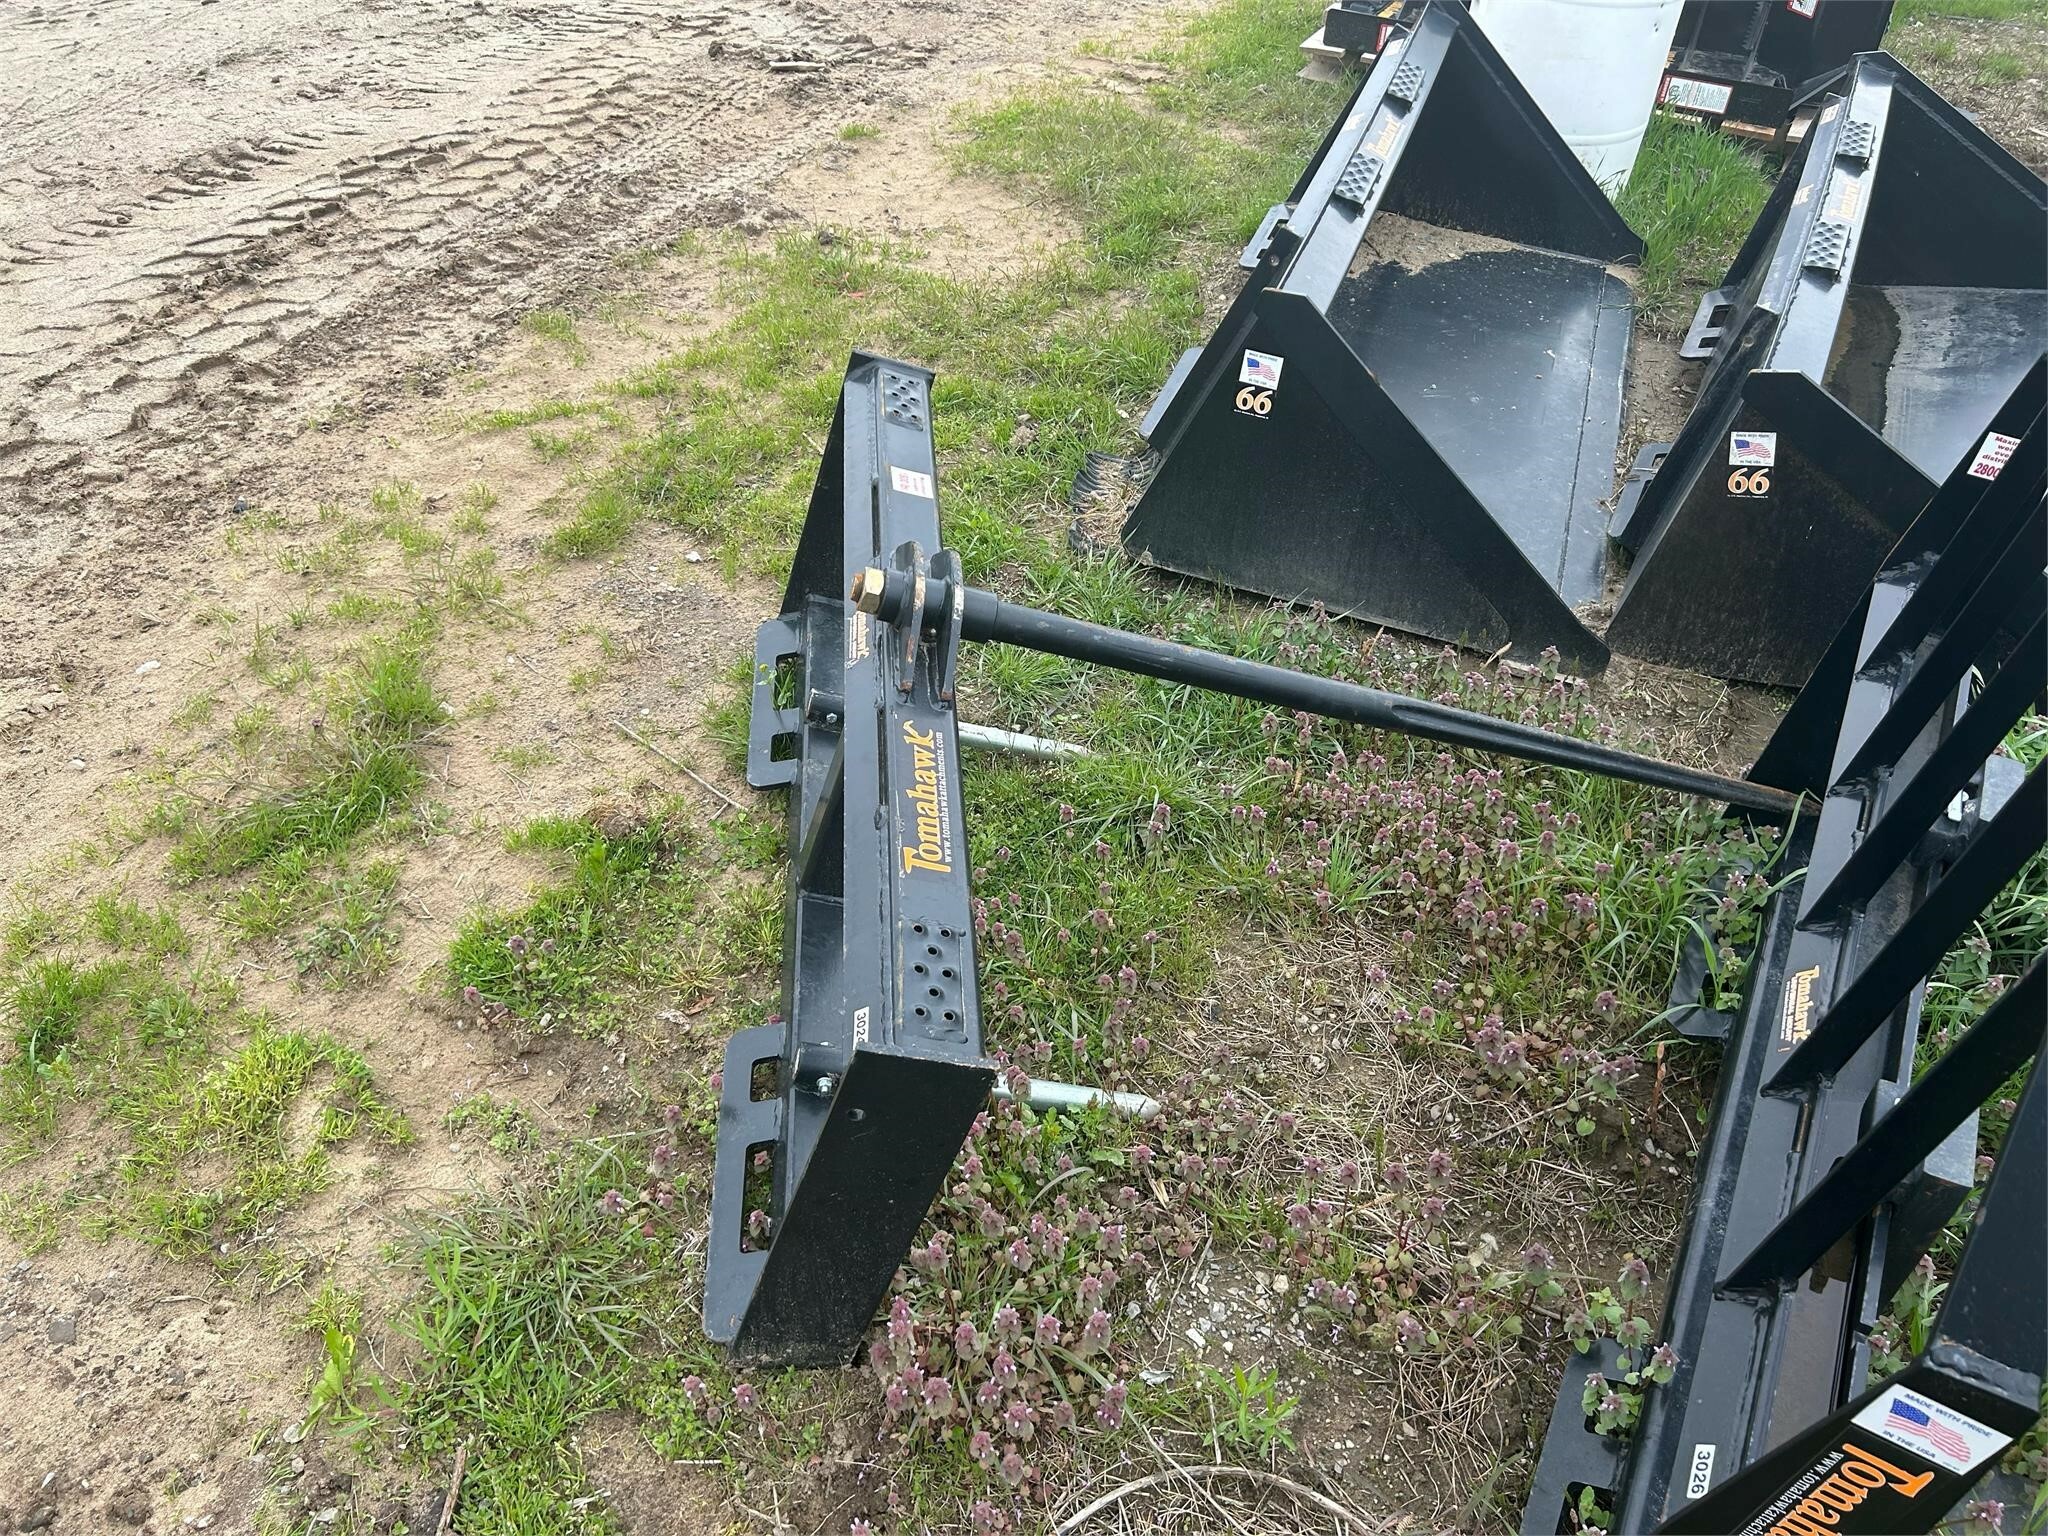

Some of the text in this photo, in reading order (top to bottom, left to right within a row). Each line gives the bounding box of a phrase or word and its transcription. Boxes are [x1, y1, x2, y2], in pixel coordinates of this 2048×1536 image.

[1236, 386, 1273, 415] 66
[1995, 450, 2010, 458] eve
[1728, 467, 1770, 495] 66
[935, 731, 953, 863] www.tomahawkattachments.com
[1904, 1393, 1993, 1438] MADE WITH PRIDE
[1882, 1429, 1936, 1459] IN THE USA
[1691, 1451, 1711, 1494] 3026
